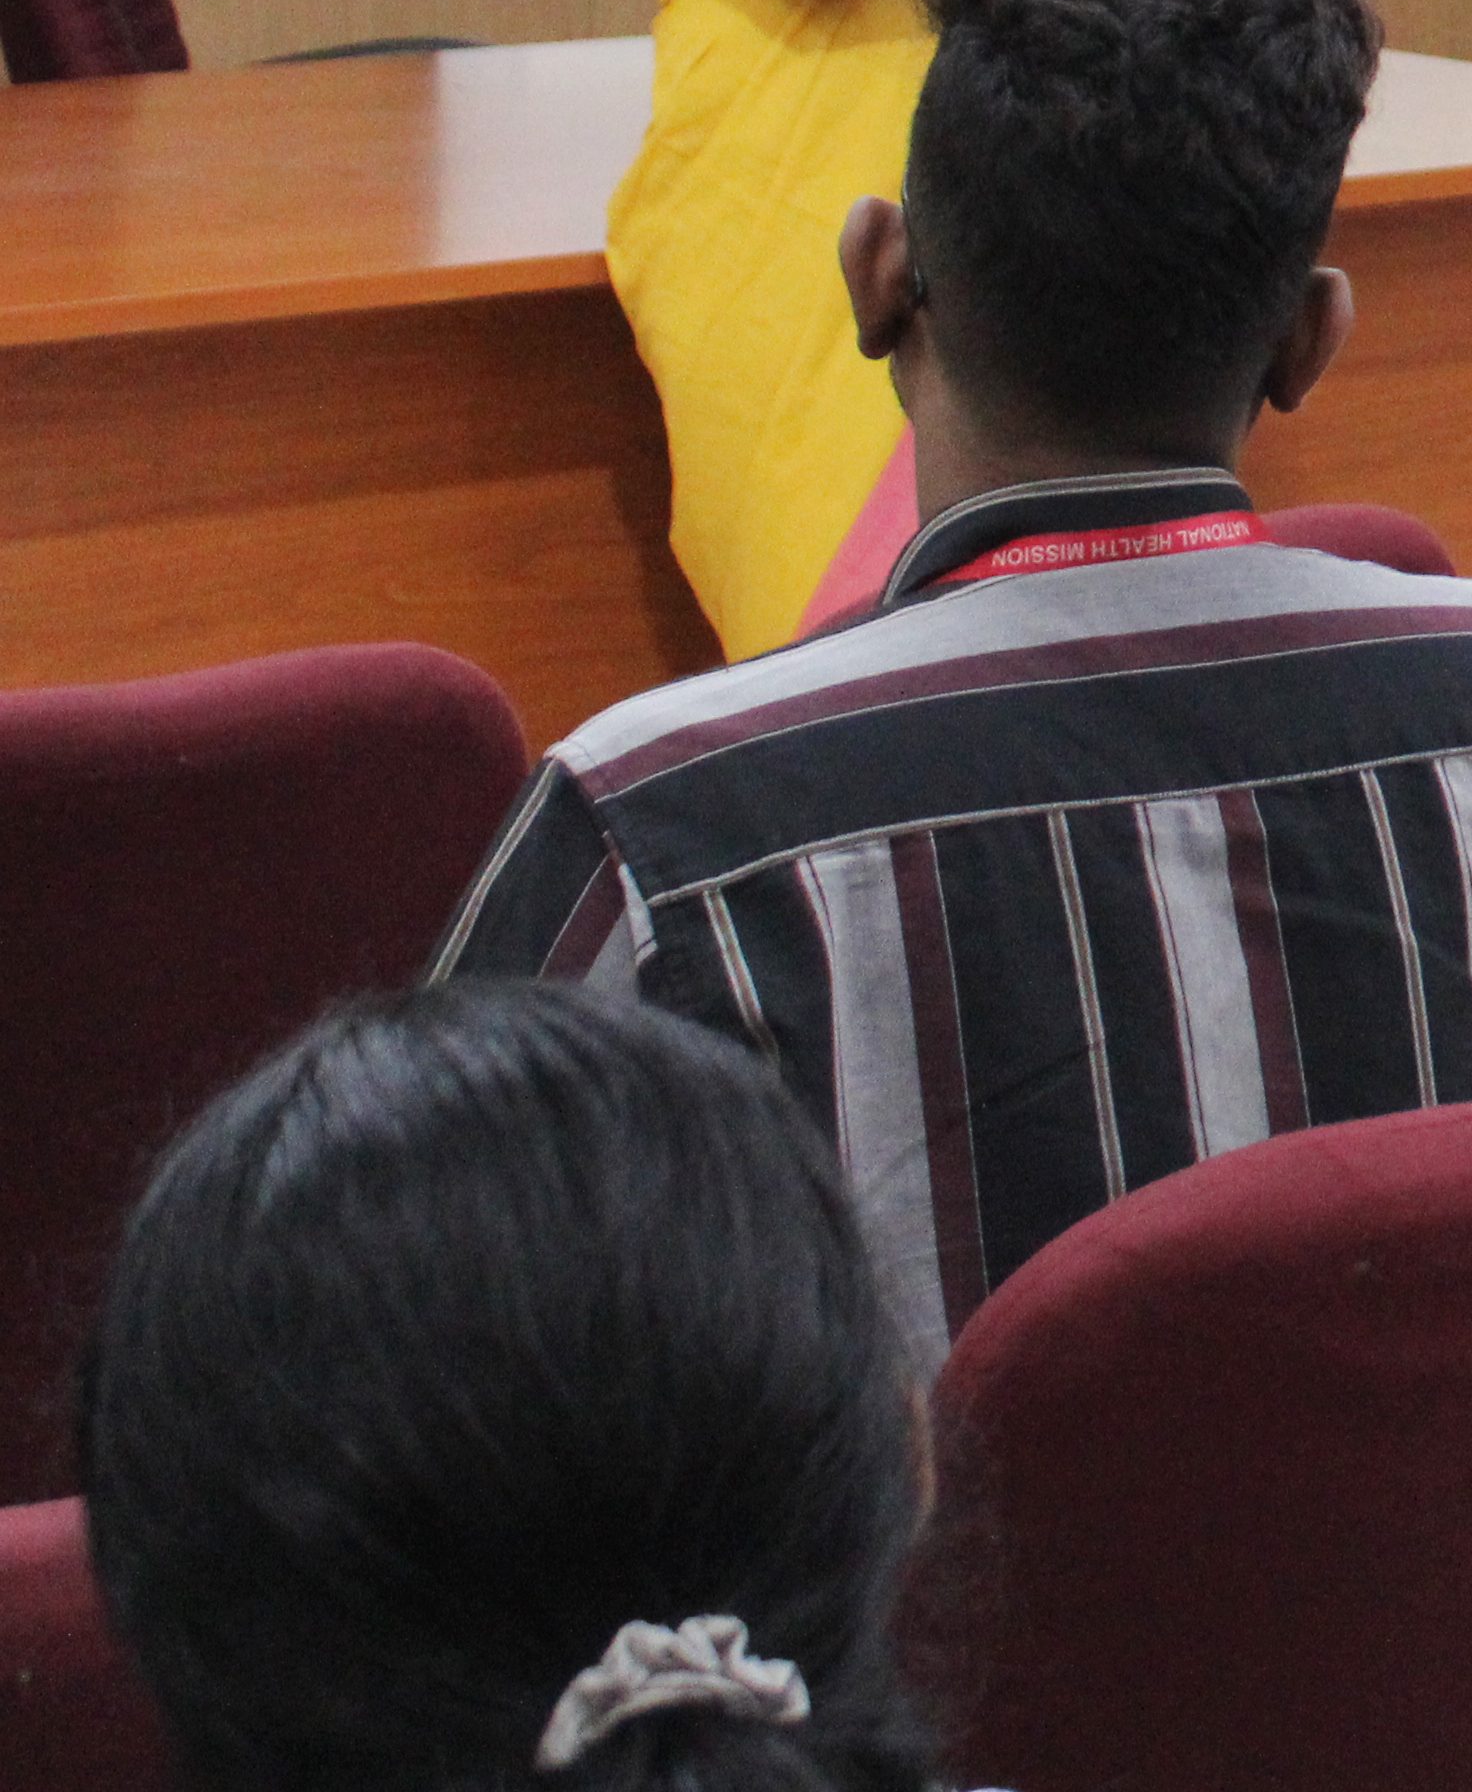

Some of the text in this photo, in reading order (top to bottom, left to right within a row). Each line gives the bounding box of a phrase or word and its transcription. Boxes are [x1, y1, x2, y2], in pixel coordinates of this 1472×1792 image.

[991, 520, 1251, 566] NATIONAL HEALTH MISSION
